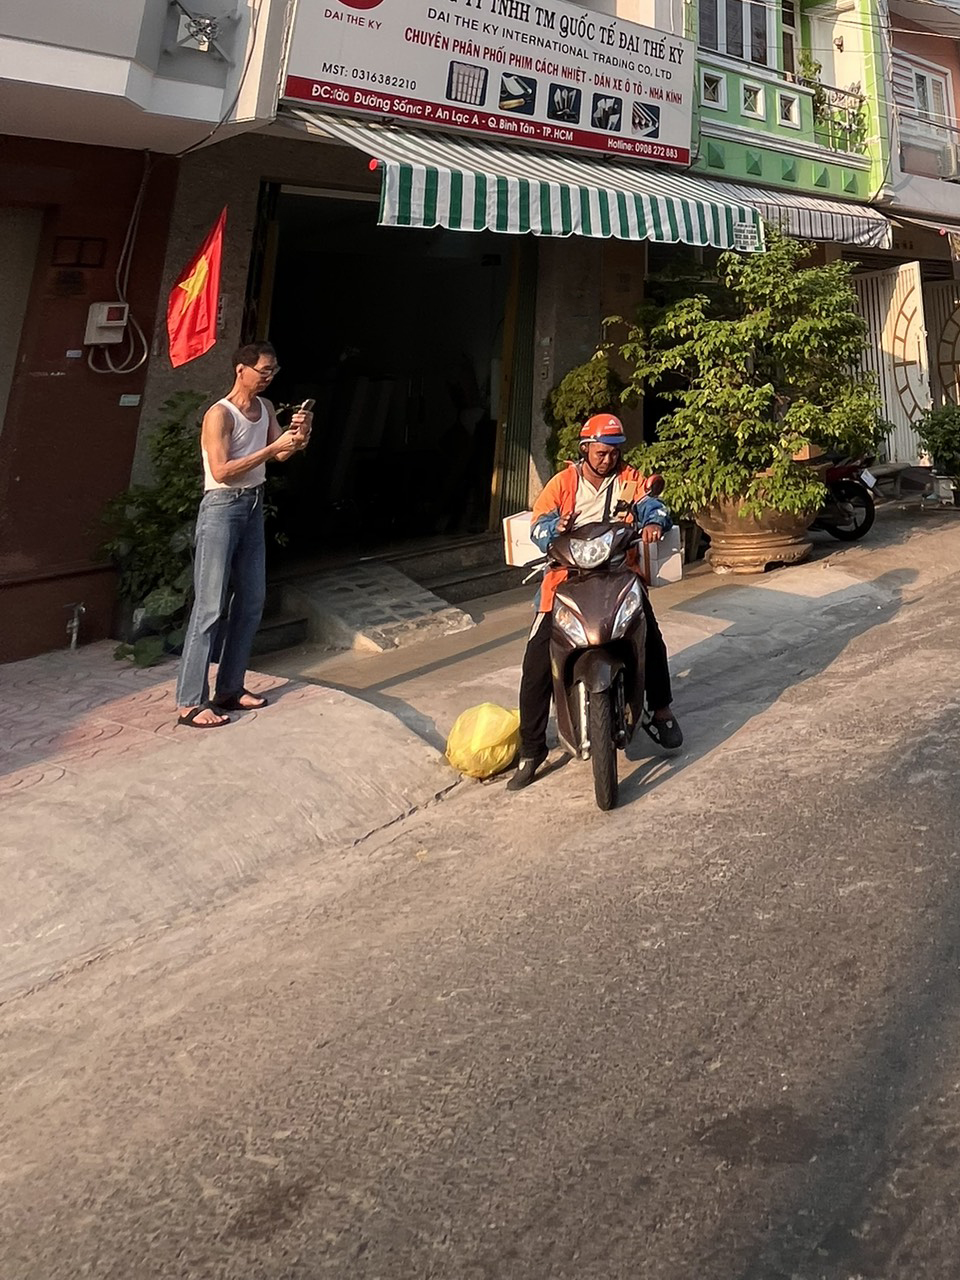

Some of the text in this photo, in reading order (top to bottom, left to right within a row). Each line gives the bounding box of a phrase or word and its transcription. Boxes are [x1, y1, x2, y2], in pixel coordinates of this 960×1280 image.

[324, 8, 382, 30] DAI THE KY
[535, 6, 556, 30] TM
[559, 13, 595, 40] QUỐC
[599, 21, 617, 47] TẾ
[618, 33, 640, 55] ĐẠI
[643, 36, 667, 60] THẾ
[404, 27, 450, 51] CHUYÊN
[452, 38, 481, 58] PHÂN
[483, 45, 506, 64] PHỐI
[509, 53, 533, 70] PHIM
[535, 57, 559, 76] CÁCH
[561, 66, 587, 84] NHIỆT
[594, 72, 611, 88] DÁN
[613, 78, 623, 91] XE
[625, 77, 631, 93] Ô
[633, 81, 643, 95] TÔ
[427, 7, 450, 23] DAI
[454, 14, 479, 31] THE
[482, 22, 499, 36] KY
[502, 27, 589, 60] INTERNATIONAL
[592, 51, 635, 71] TRADING
[655, 67, 672, 80] LTD
[322, 62, 417, 91] MST: 0316382210
[354, 91, 391, 112] Đường
[435, 107, 449, 120] An
[451, 110, 470, 125] Lạc
[471, 114, 479, 125] A
